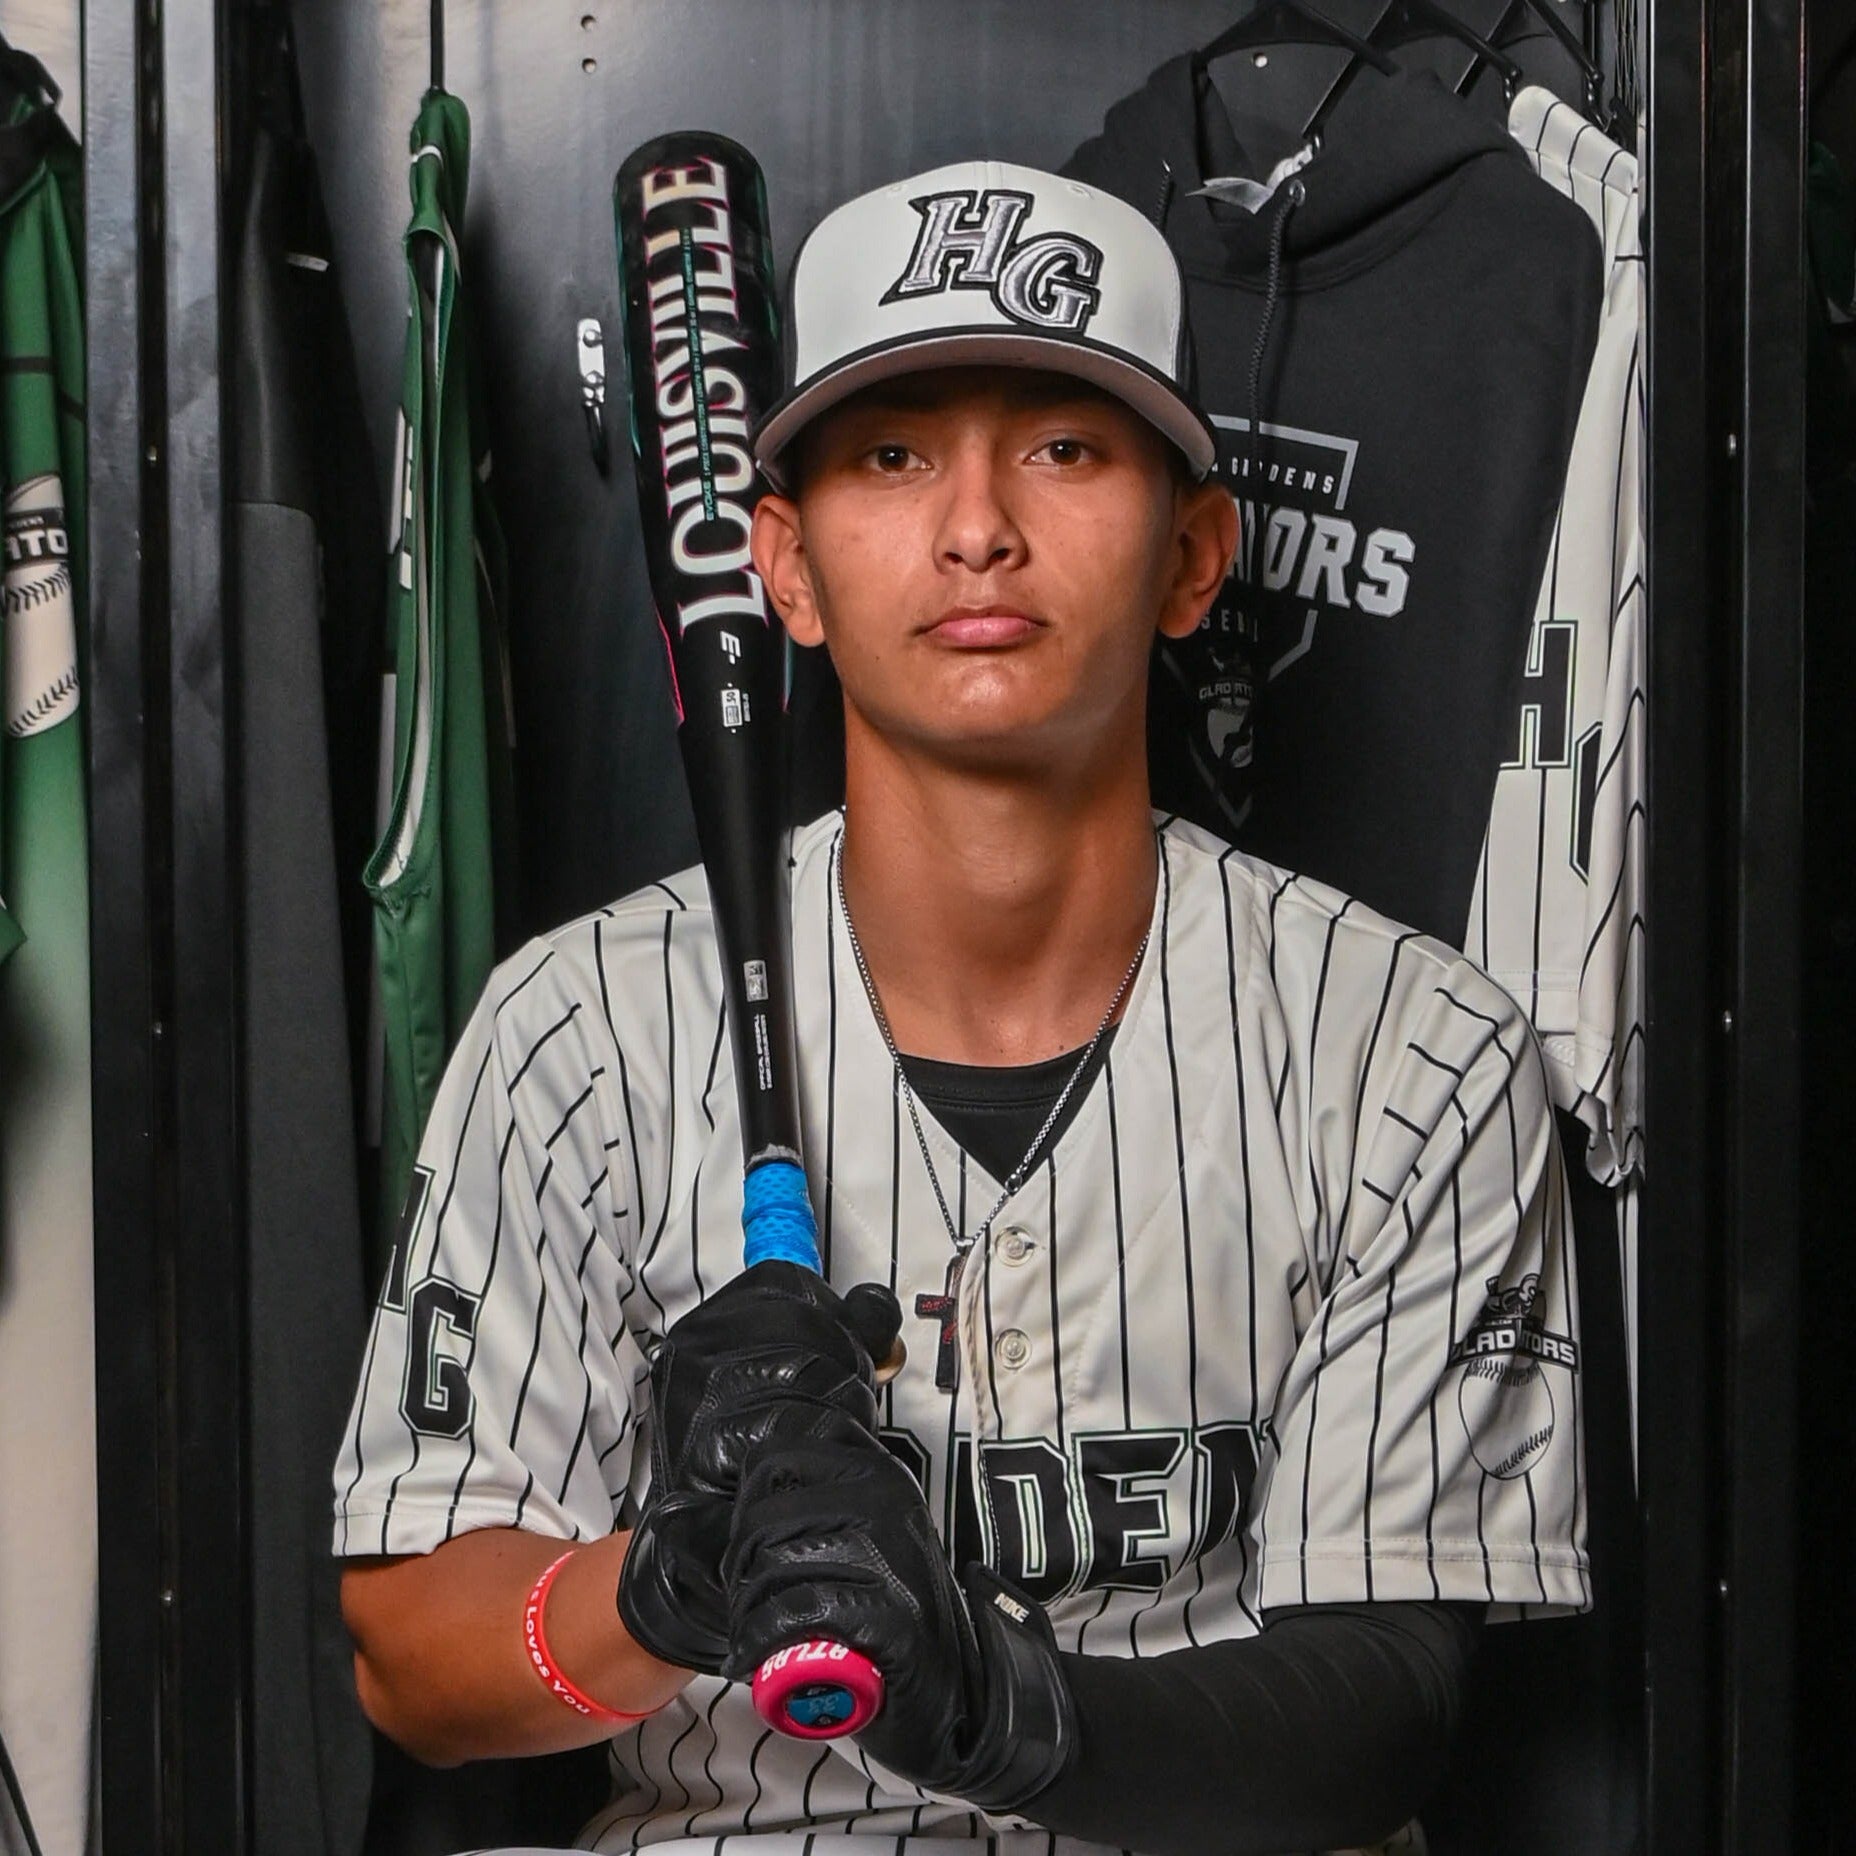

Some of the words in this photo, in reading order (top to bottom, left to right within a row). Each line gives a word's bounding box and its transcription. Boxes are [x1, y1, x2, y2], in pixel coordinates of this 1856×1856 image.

[878, 189, 1104, 336] HG
[641, 155, 768, 637] LOUISVILLE
[1231, 456, 1335, 494] GADENS
[993, 1592, 1030, 1623] NIKE
